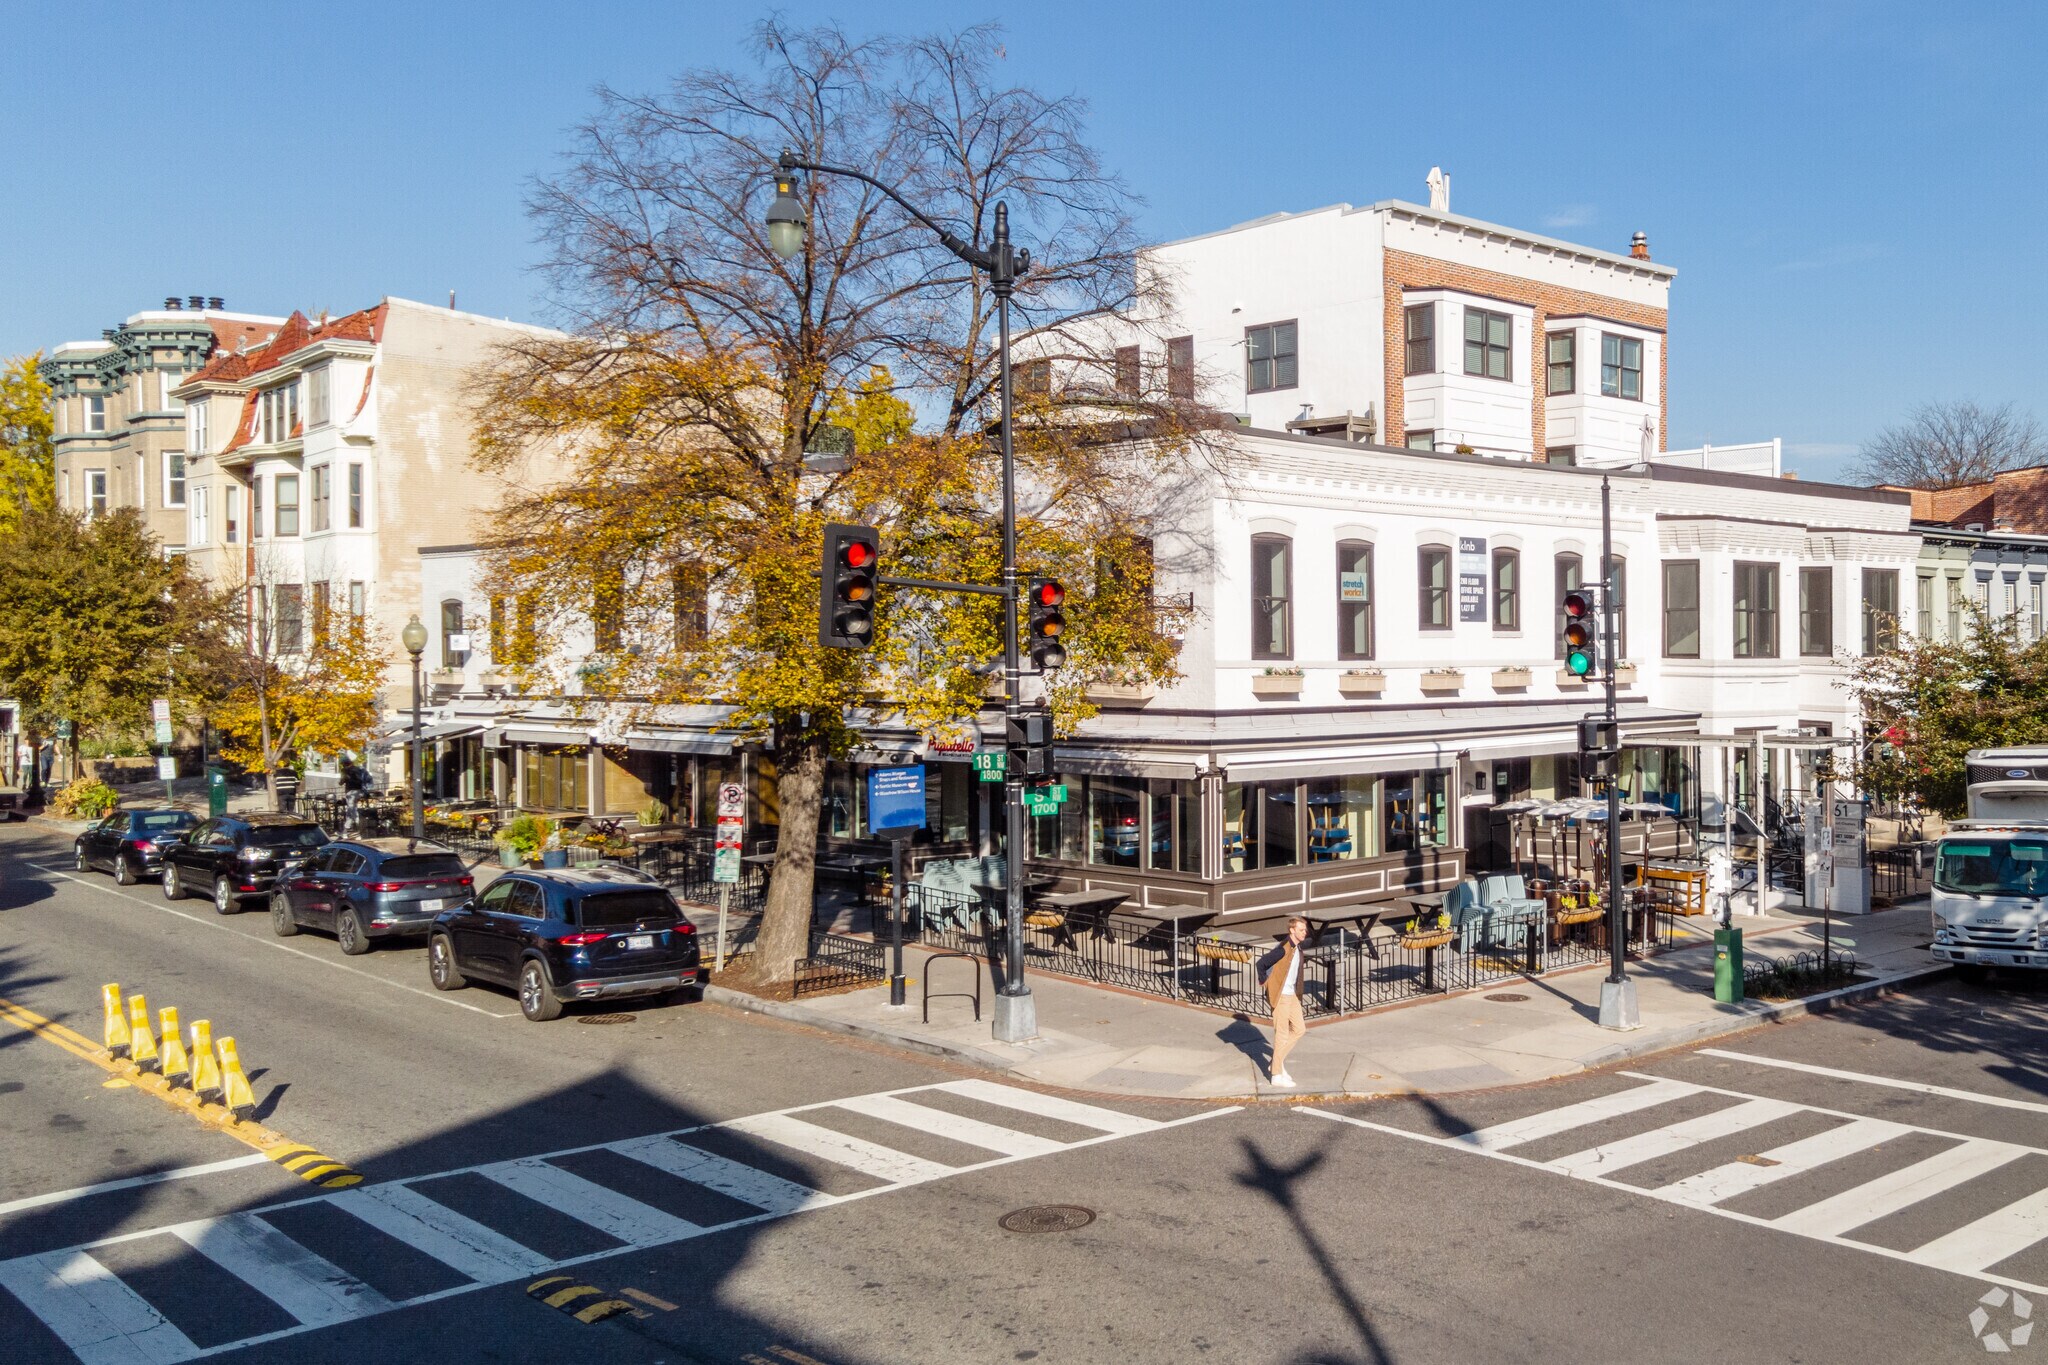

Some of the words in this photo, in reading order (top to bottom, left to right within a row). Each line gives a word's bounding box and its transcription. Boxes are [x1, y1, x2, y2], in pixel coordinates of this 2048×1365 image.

[976, 755, 991, 769] 18
[982, 770, 1002, 779] 1800
[1034, 788, 1045, 802] S
[1052, 786, 1061, 794] ST
[1034, 803, 1057, 814] 1700
[1819, 804, 1848, 817] 161
